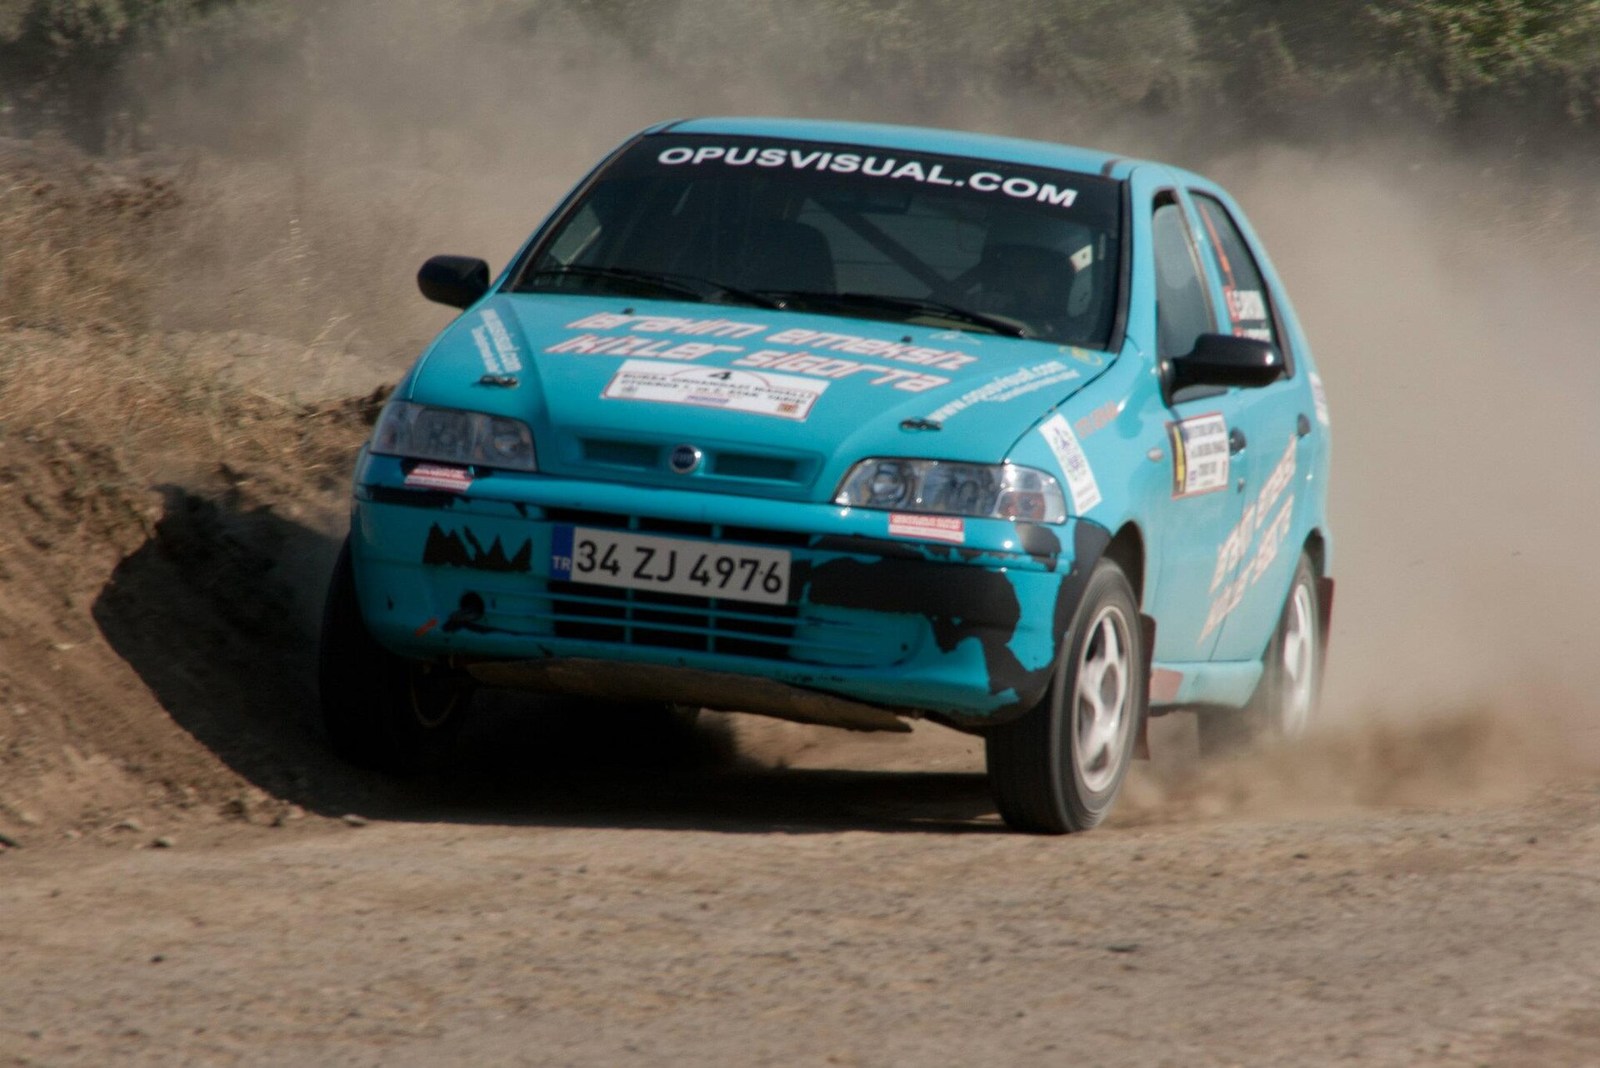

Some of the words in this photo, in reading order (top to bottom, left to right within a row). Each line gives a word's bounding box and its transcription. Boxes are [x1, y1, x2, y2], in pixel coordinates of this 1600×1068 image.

[657, 146, 1078, 208] OPUSVISUAL.COM
[708, 370, 733, 381] 4
[552, 555, 572, 571] TR
[576, 540, 621, 576] 34
[633, 546, 677, 582] ZJ
[689, 553, 783, 594] 4976
